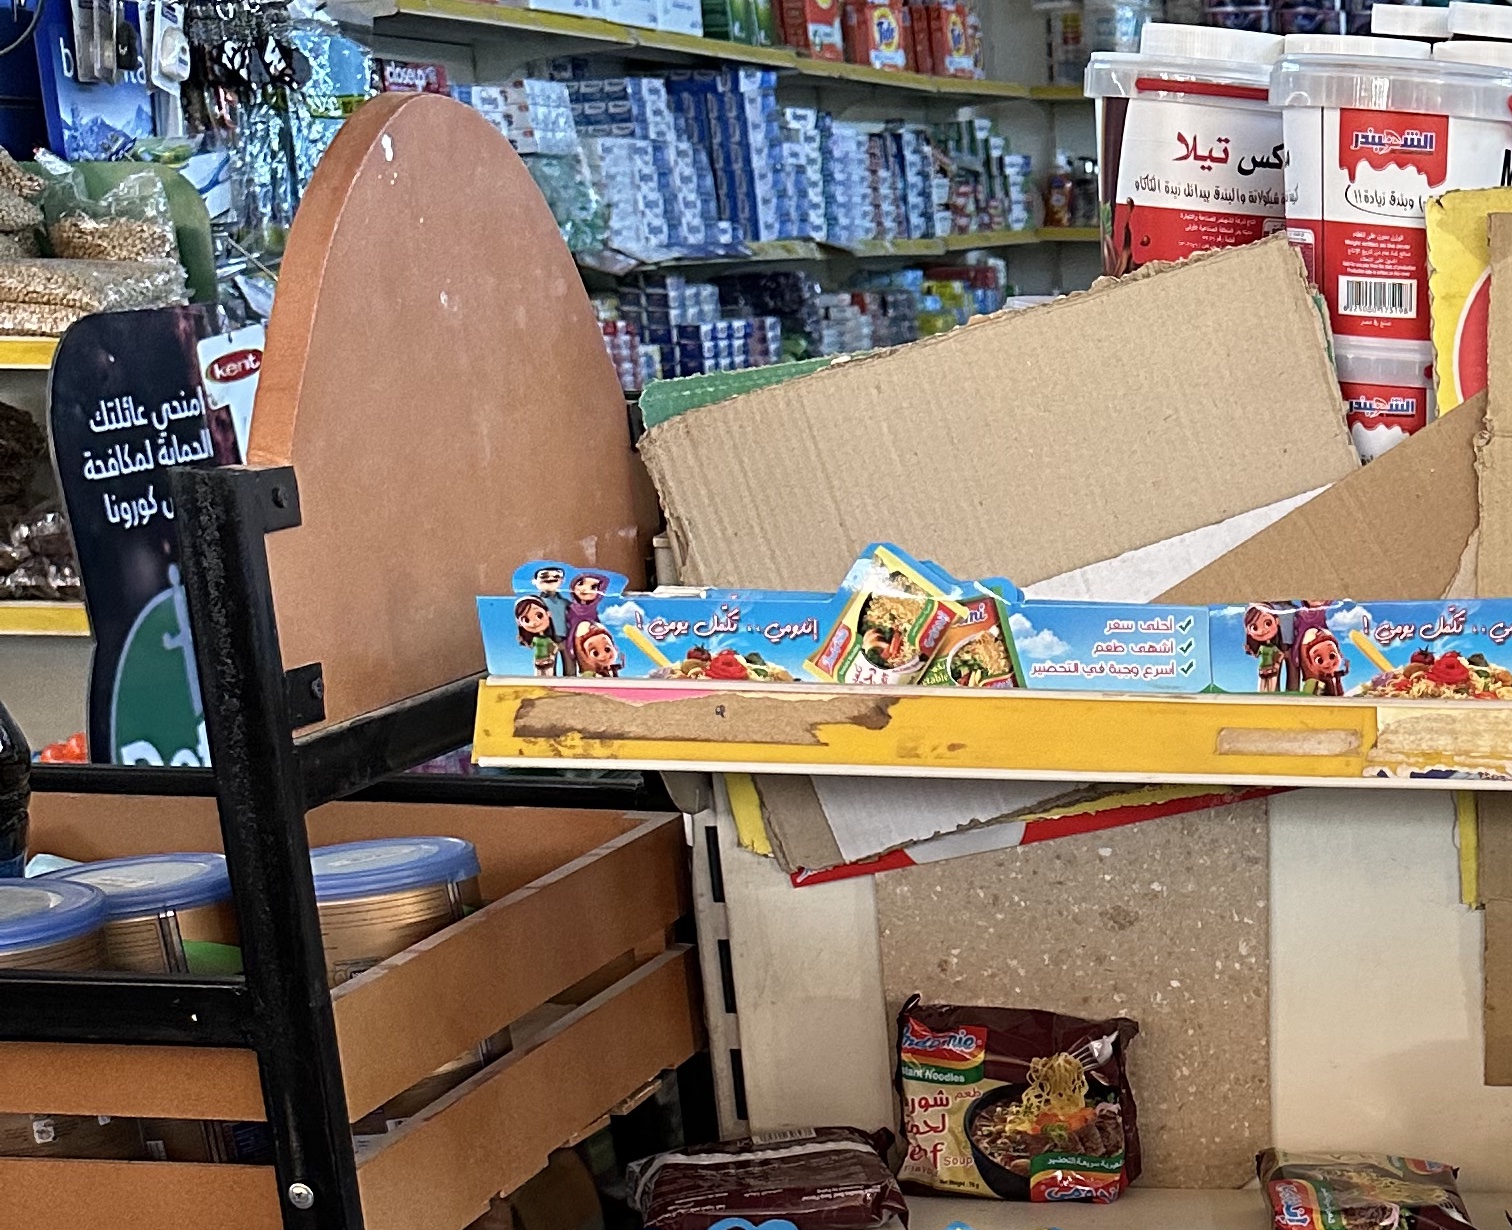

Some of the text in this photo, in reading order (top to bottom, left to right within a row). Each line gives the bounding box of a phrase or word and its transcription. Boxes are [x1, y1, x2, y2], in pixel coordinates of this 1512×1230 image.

[1172, 131, 1231, 172] تيلا
[213, 353, 261, 380] kent
[90, 396, 149, 433] عائلتك
[83, 440, 155, 481] لمكافحة
[103, 485, 158, 529] كورونا
[1106, 620, 1134, 633] سعر
[1093, 642, 1126, 655] طعم
[1031, 662, 1079, 676] التحضير
[1082, 663, 1106, 677] في
[1109, 664, 1140, 677] وجبة
[924, 1068, 965, 1082] Noodles
[954, 1087, 982, 1100] طعم
[943, 1155, 975, 1167] Soup
